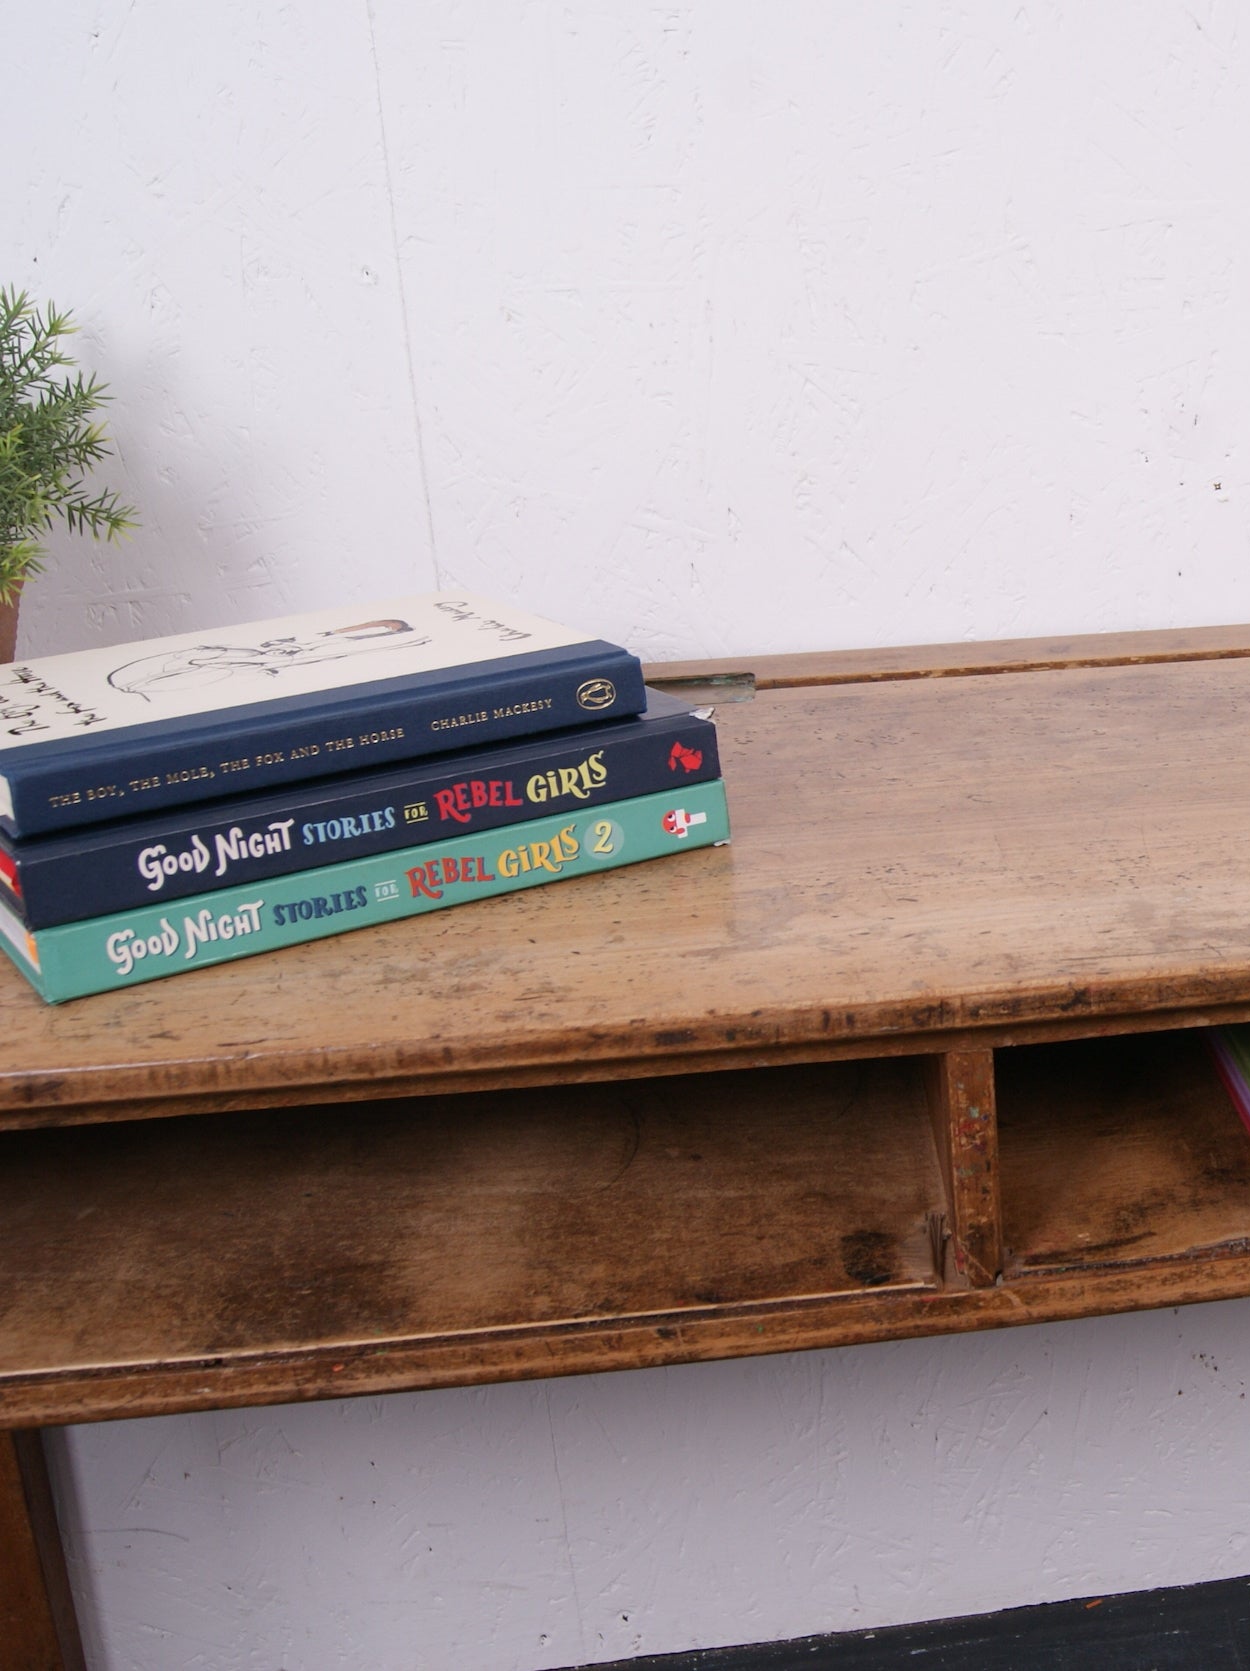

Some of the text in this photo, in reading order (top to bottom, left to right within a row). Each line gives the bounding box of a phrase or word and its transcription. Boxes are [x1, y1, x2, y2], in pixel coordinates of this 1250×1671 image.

[48, 698, 553, 808] THE BOY, THE MOLE, THE FOX AND THE HORSE CHARLIE MACKESY
[302, 806, 396, 846] STORIES
[404, 806, 428, 820] FOR
[433, 780, 523, 824] REBEL
[272, 885, 368, 926] STORIES
[375, 883, 399, 898] FOR
[404, 857, 495, 899] REBEL
[593, 821, 614, 854] 2
